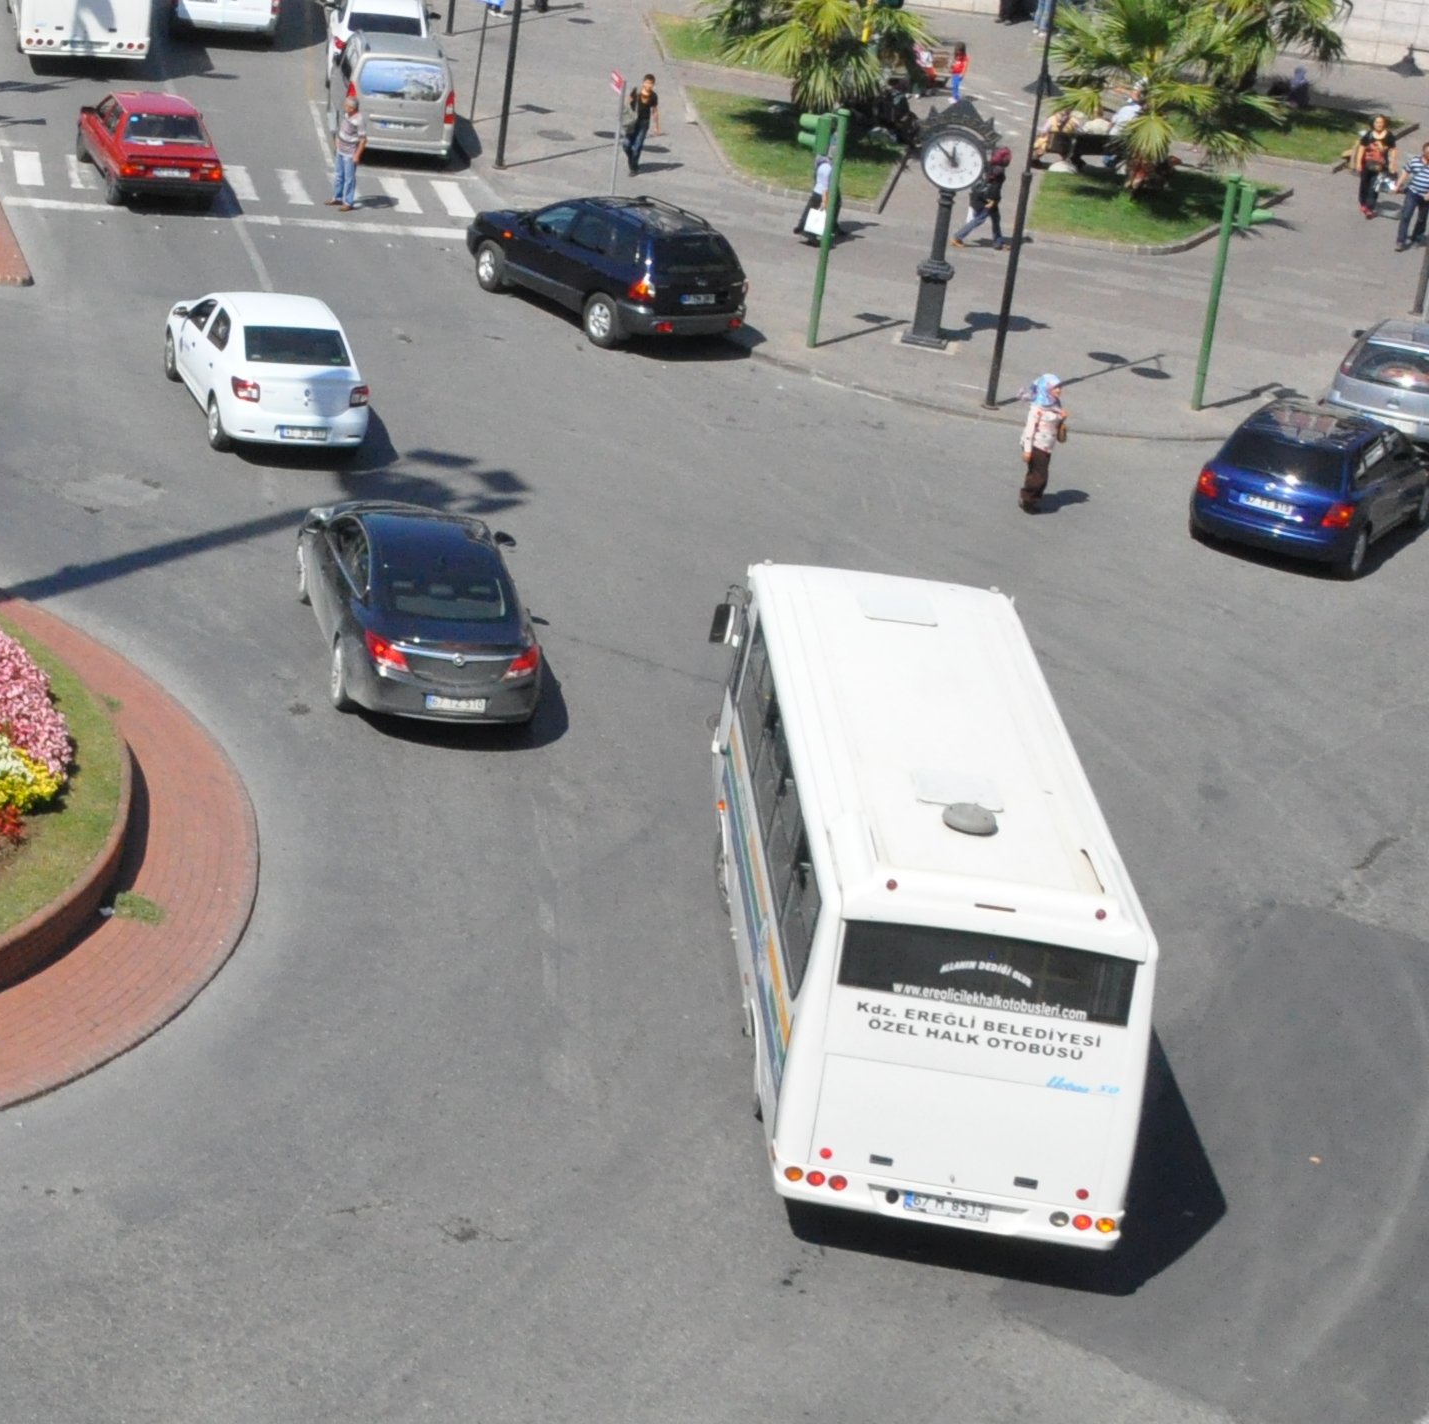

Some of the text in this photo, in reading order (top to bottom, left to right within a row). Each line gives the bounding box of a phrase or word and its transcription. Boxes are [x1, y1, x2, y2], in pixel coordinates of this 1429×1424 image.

[857, 1001, 1102, 1048] Kdz. EREĞLİ BELEDİYESİ
[868, 1016, 1084, 1061] ÖZEL HALK OTOBÜSÜ
